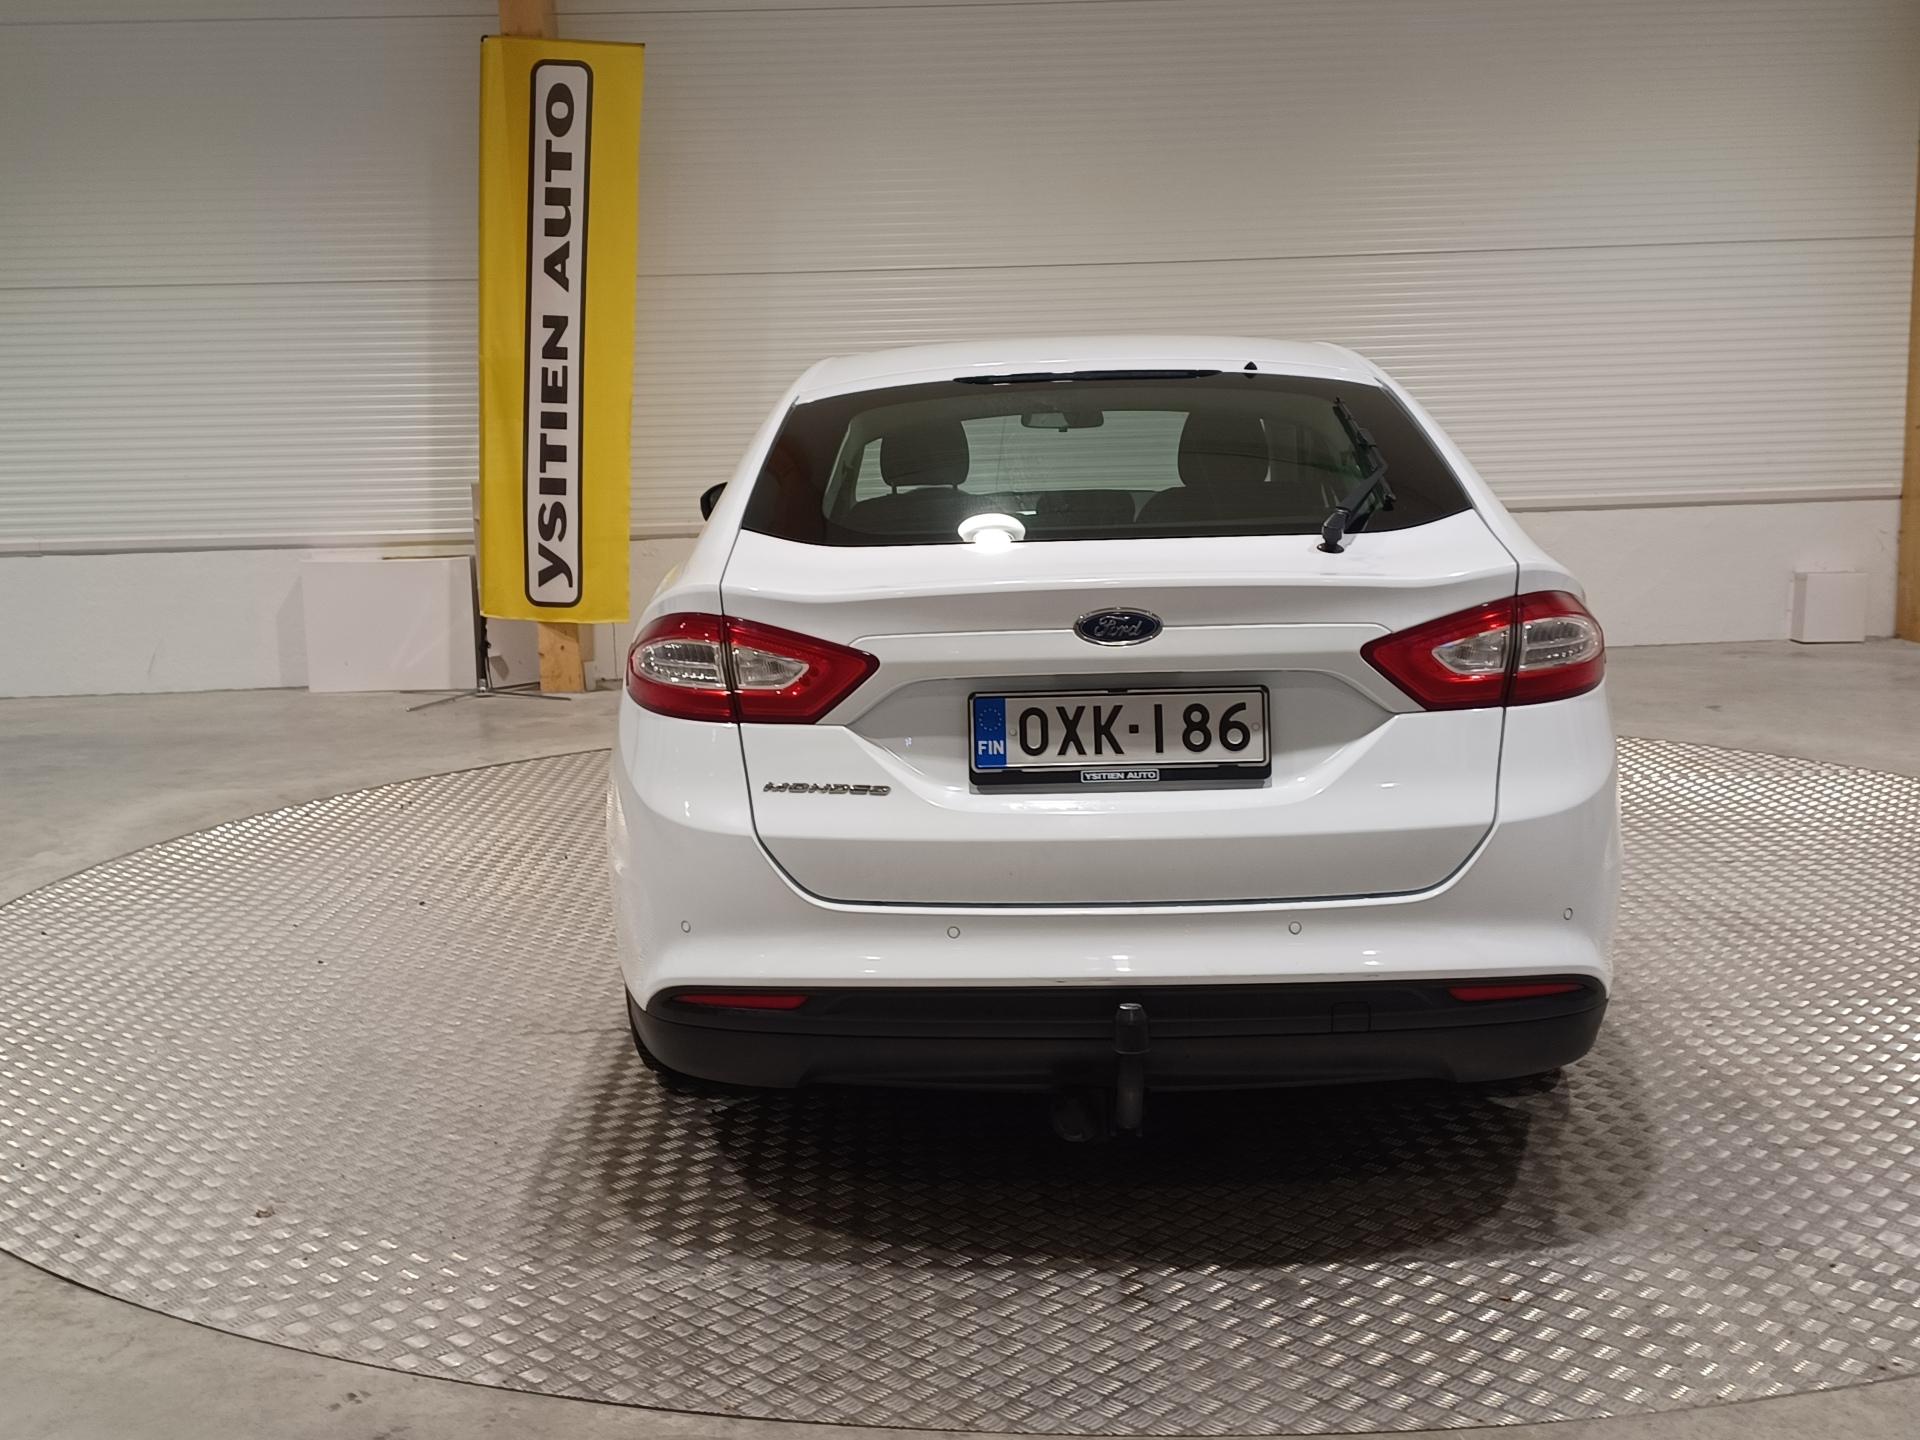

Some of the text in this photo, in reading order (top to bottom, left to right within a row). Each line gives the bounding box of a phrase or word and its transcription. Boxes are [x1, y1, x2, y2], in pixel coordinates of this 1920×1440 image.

[538, 83, 574, 588] YSITIEN AUTO
[1094, 615, 1143, 637] Ford
[977, 740, 1004, 755] FIN
[1084, 771, 1156, 780] YSITIEN AUTO
[763, 782, 892, 796] MONDEO
